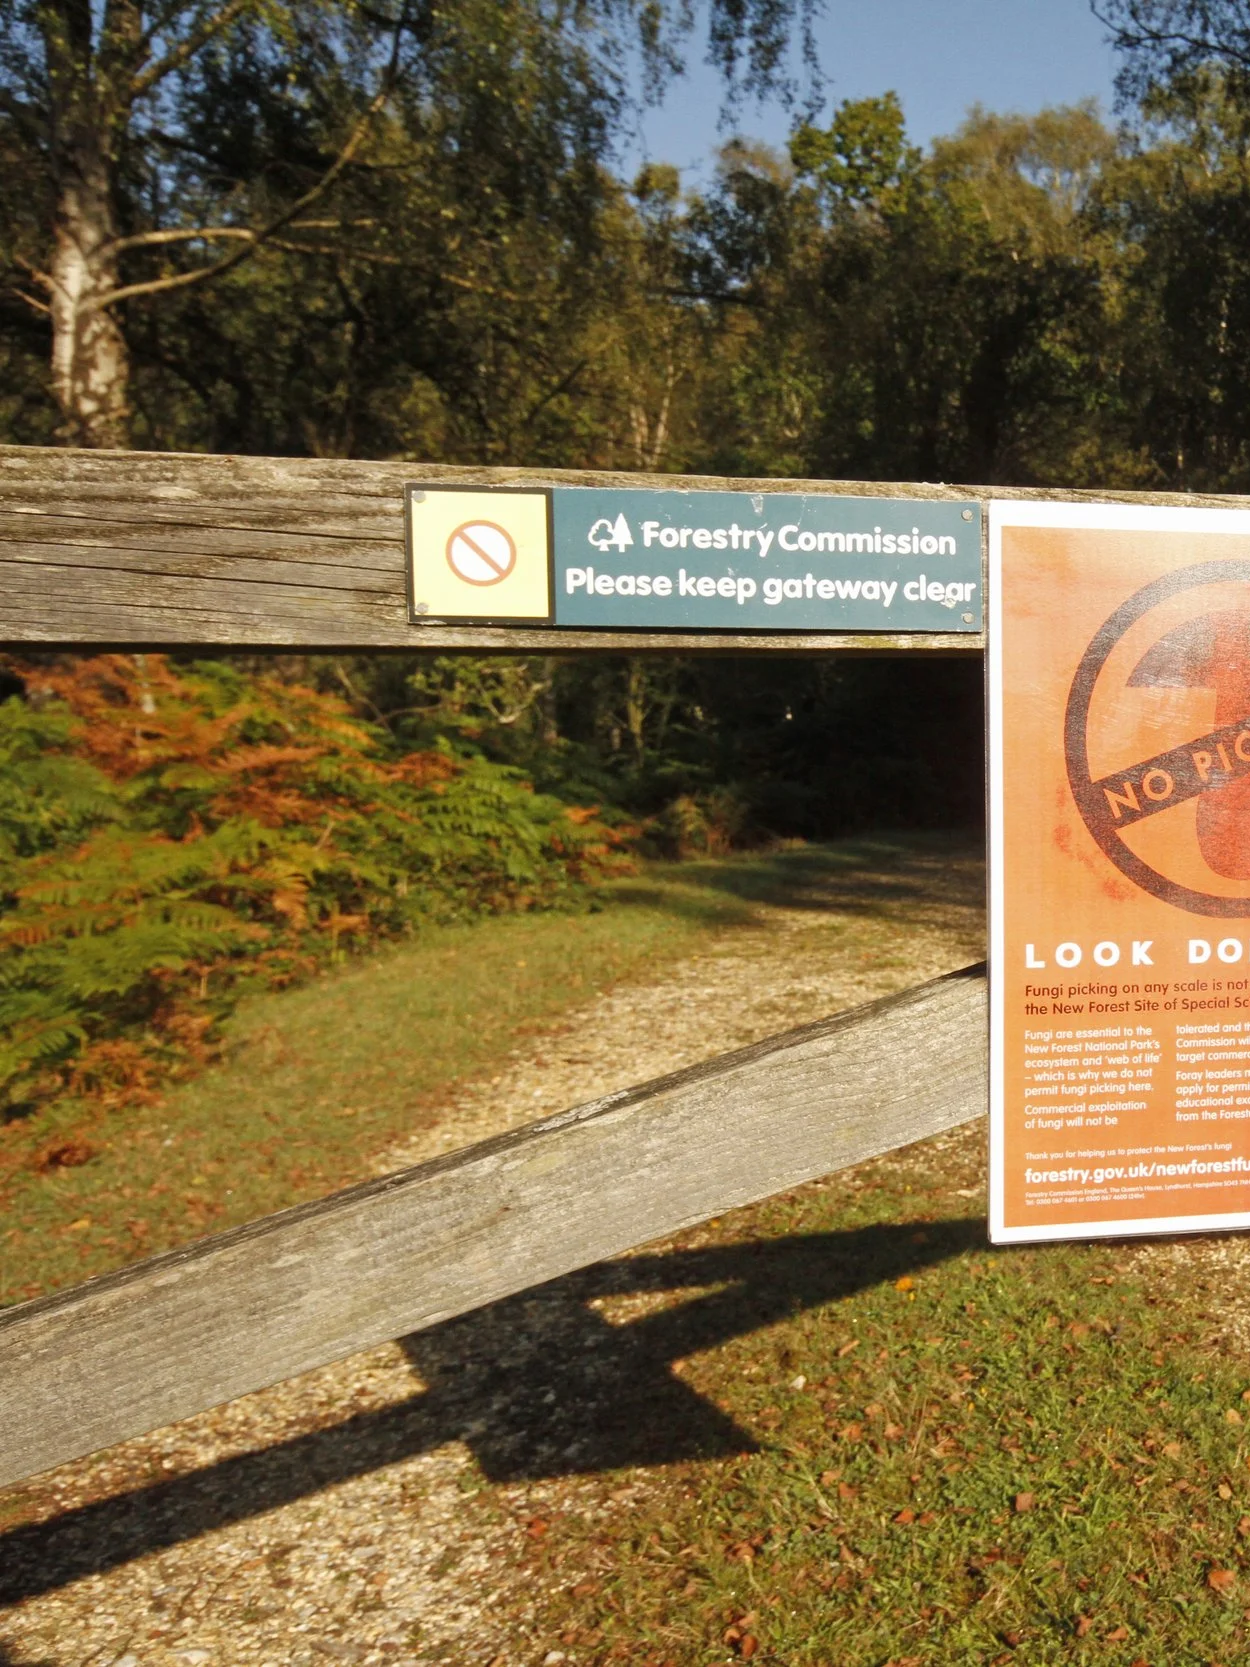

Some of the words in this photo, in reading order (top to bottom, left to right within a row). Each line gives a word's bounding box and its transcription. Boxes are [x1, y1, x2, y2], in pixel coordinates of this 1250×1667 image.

[642, 520, 774, 557] Forestry
[778, 525, 956, 555] Commission
[566, 568, 672, 597] Please
[679, 569, 757, 604] keep
[763, 574, 898, 607] gateway
[903, 575, 976, 603] clear
[1102, 768, 1174, 820] NO
[1025, 941, 1155, 969] LOOK
[1025, 984, 1064, 999] Fungi
[1068, 982, 1117, 998] picking
[1123, 983, 1140, 993] on
[1144, 981, 1168, 995] any
[1173, 978, 1208, 992] scale
[1213, 978, 1223, 991] is
[1226, 978, 1249, 990] not
[1025, 1002, 1048, 1015] the
[1052, 1001, 1084, 1014] New
[1089, 999, 1130, 1013] Forest
[1134, 998, 1159, 1011] Site
[1163, 997, 1177, 1010] of
[1181, 996, 1230, 1012] Special
[1024, 1030, 1052, 1042] Fungi
[1056, 1031, 1072, 1039] are
[1076, 1028, 1120, 1038] essential
[1124, 1028, 1133, 1037] to
[1136, 1026, 1152, 1036] the
[1176, 1023, 1219, 1034] tolerated
[1222, 1023, 1241, 1032] and
[1025, 1045, 1048, 1054] New
[1052, 1043, 1082, 1052] Forest
[1085, 1041, 1128, 1052] National
[1176, 1038, 1235, 1048] Commission
[1025, 1058, 1079, 1069] ecosystem
[1082, 1057, 1102, 1066] and
[1132, 1054, 1143, 1064] of
[1176, 1053, 1205, 1063] target
[1034, 1071, 1064, 1081] which
[1068, 1071, 1076, 1080] is
[1079, 1070, 1099, 1081] why
[1102, 1070, 1117, 1078] we
[1121, 1069, 1133, 1078] do
[1136, 1068, 1152, 1077] not
[1176, 1071, 1203, 1081] Foray
[1205, 1069, 1242, 1079] leaders
[1025, 1086, 1058, 1097] permit
[1061, 1084, 1087, 1096] fungi
[1090, 1083, 1126, 1095] picking
[1128, 1082, 1154, 1091] here.
[1176, 1084, 1203, 1095] apply
[1206, 1084, 1219, 1093] for
[1025, 1104, 1085, 1115] Commercial
[1088, 1101, 1147, 1113] exploitation
[1176, 1097, 1233, 1108] educational
[1025, 1119, 1034, 1129] of
[1038, 1118, 1063, 1130] fungi
[1066, 1117, 1083, 1127] will
[1086, 1116, 1102, 1126] not
[1105, 1116, 1118, 1125] be
[1176, 1112, 1198, 1121] from
[1202, 1111, 1217, 1120] the
[1025, 1152, 1048, 1160] Thank
[1078, 1150, 1105, 1158] helping
[1127, 1147, 1152, 1156] protect
[1214, 1142, 1232, 1151] fungi
